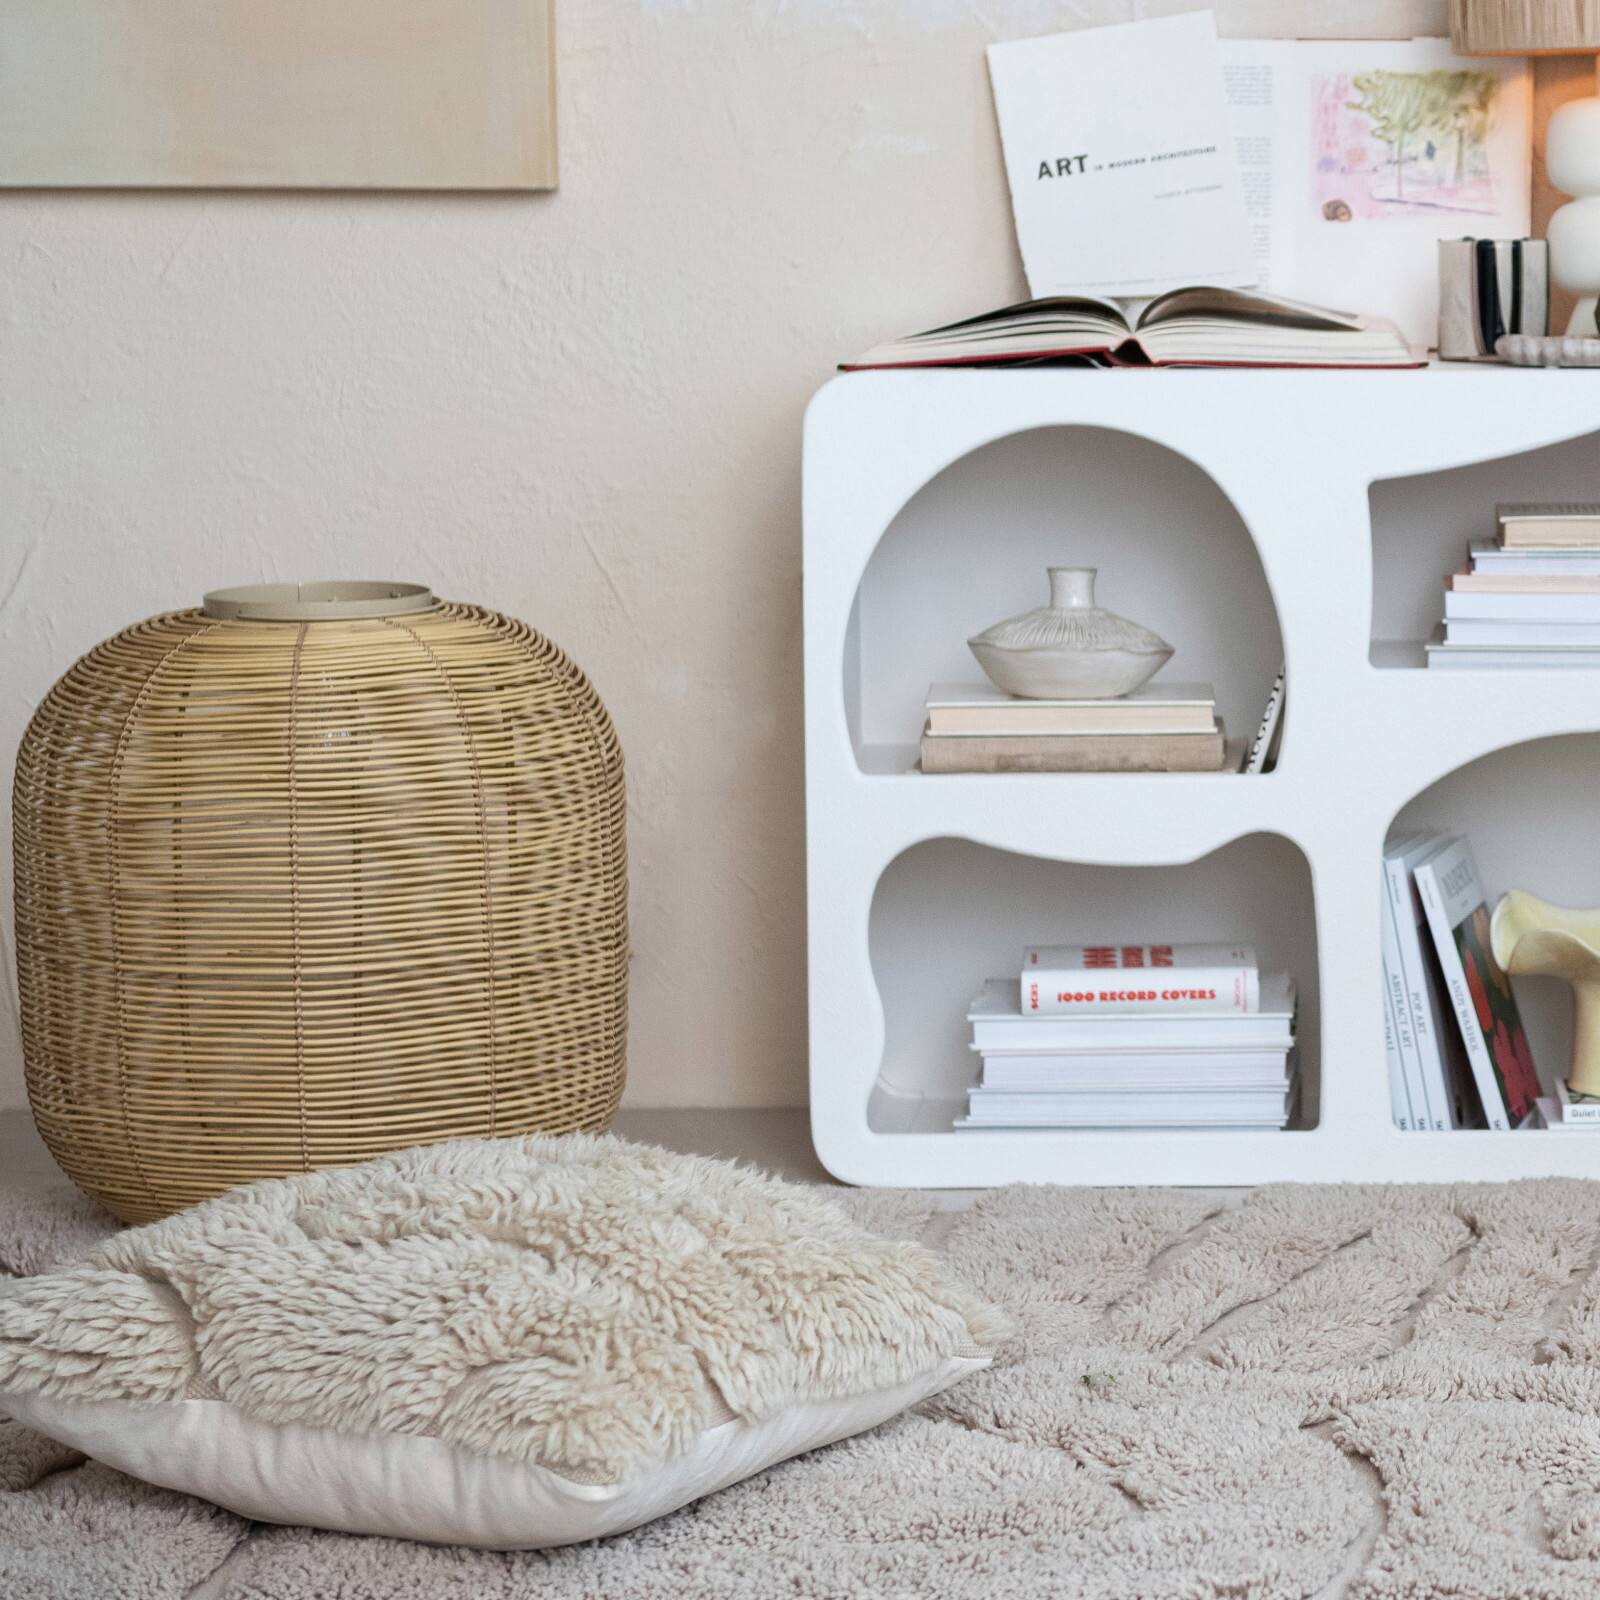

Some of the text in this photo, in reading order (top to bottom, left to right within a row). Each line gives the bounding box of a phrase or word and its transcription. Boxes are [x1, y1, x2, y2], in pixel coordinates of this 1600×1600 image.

[1038, 154, 1088, 180] ART
[1057, 988, 1217, 1002] 1000 RECORD COVERS
[1391, 974, 1412, 1049] ABSTRACT ART
[1412, 992, 1426, 1034] POP ART
[1571, 1109, 1596, 1118] Quiet
